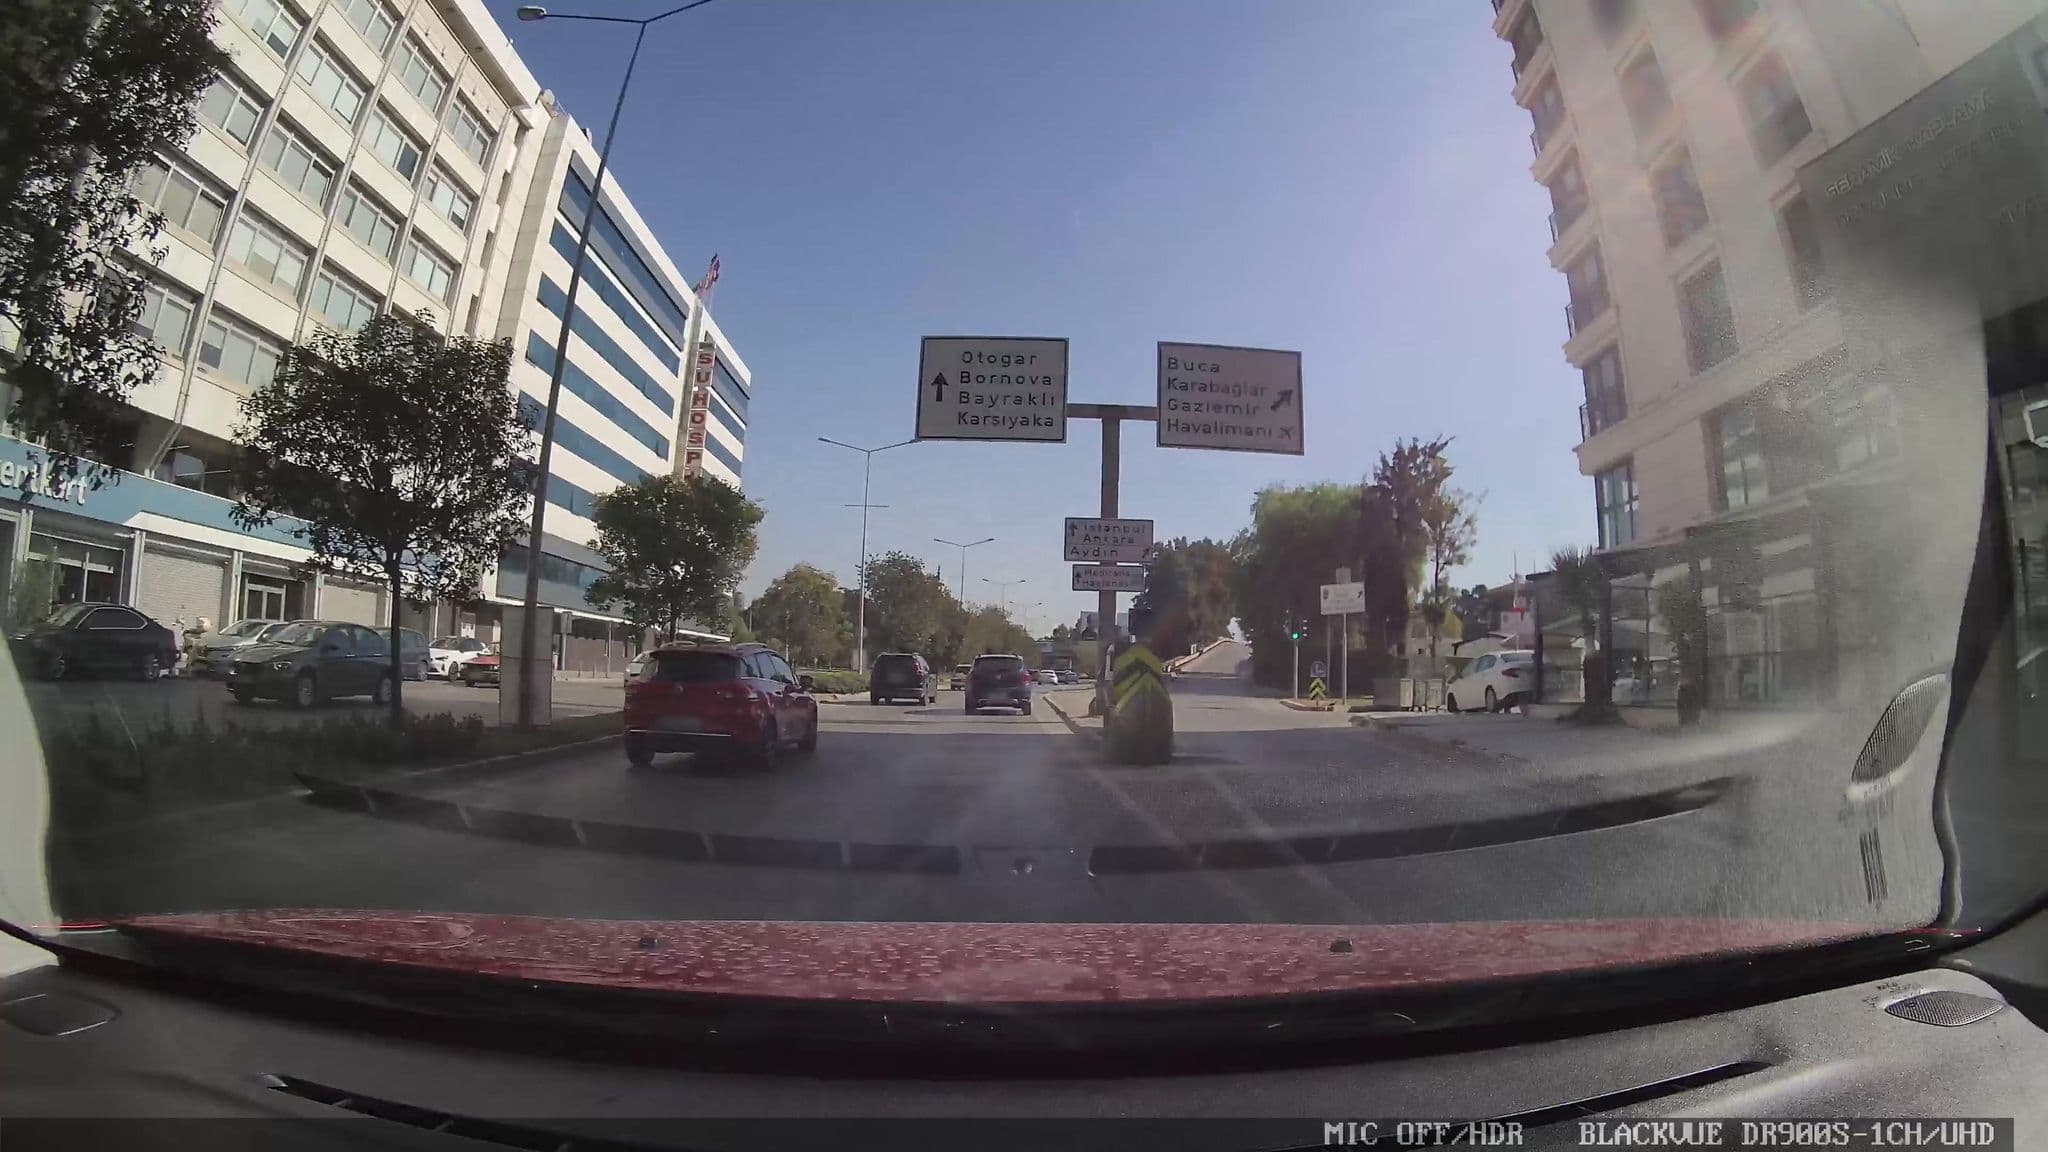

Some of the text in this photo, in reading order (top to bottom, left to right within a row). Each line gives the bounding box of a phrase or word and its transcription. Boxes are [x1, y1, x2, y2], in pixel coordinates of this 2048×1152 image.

[961, 351, 1038, 368] Otogar
[1167, 356, 1221, 373] Buca
[960, 371, 1053, 386] Bornova
[959, 391, 1055, 408] Bayraklı
[1167, 398, 1260, 416] Gaziemir
